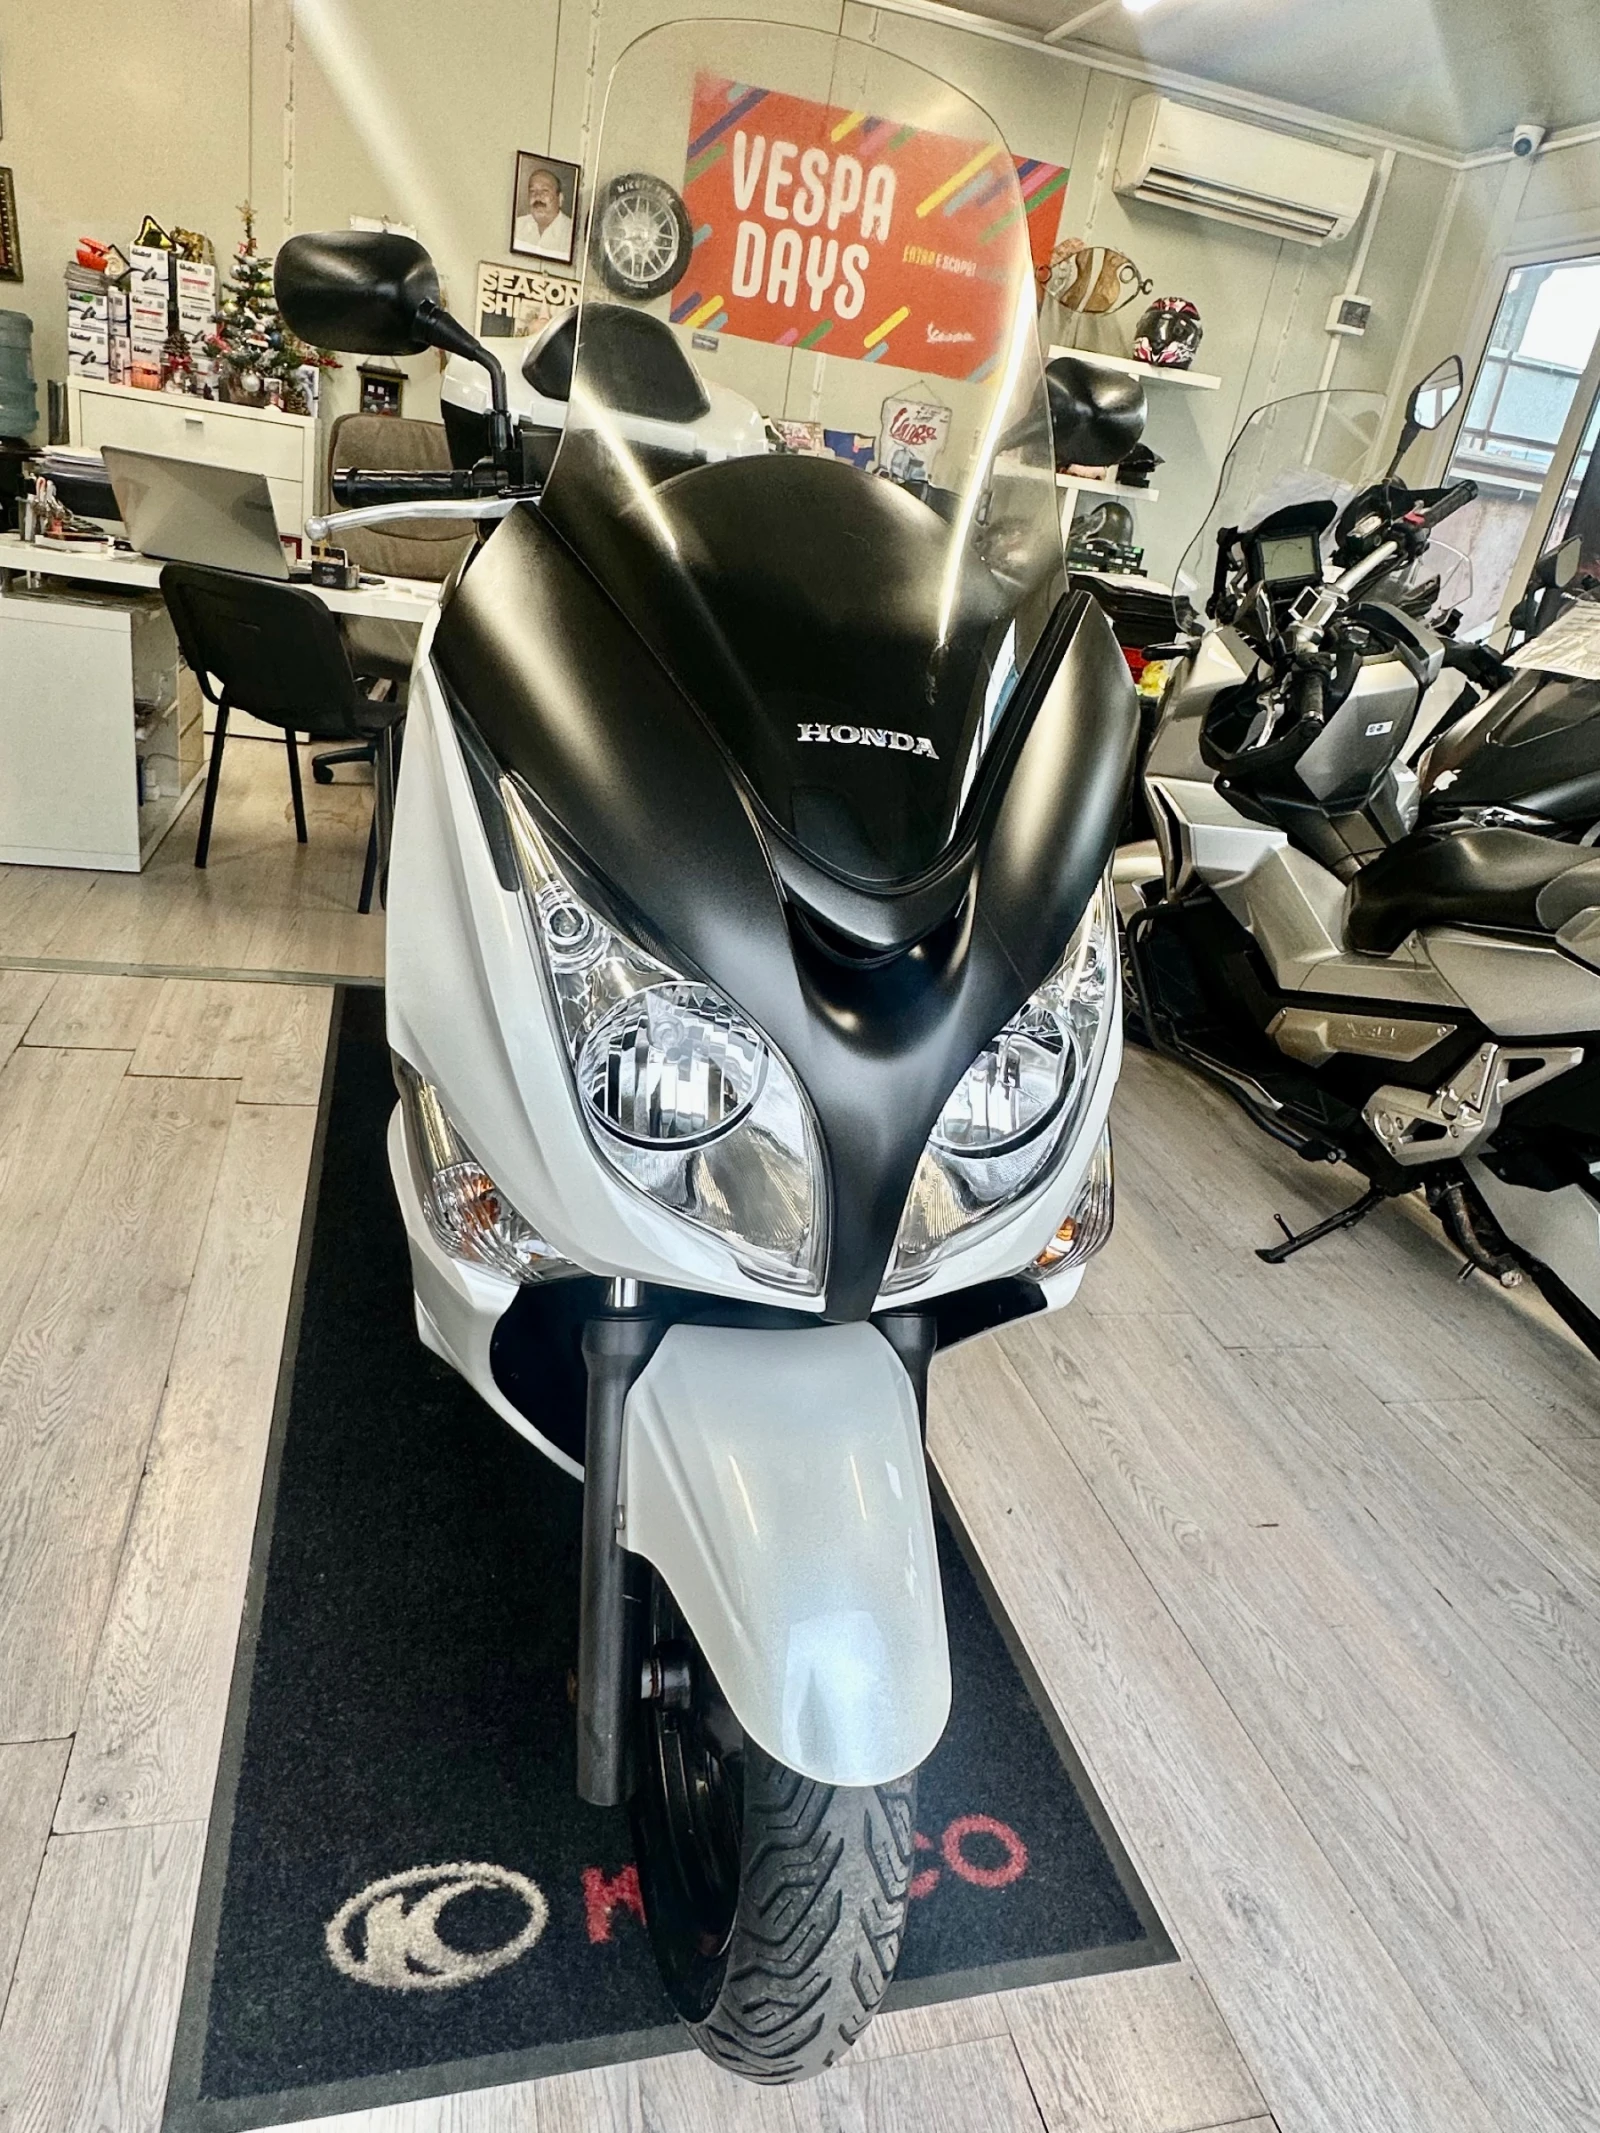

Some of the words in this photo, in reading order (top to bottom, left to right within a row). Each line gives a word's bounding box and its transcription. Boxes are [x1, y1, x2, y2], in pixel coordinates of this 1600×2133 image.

[733, 130, 896, 243] VESPA
[482, 270, 583, 306] SEASON
[731, 220, 870, 320] DAYS
[797, 722, 940, 760] HONDA
